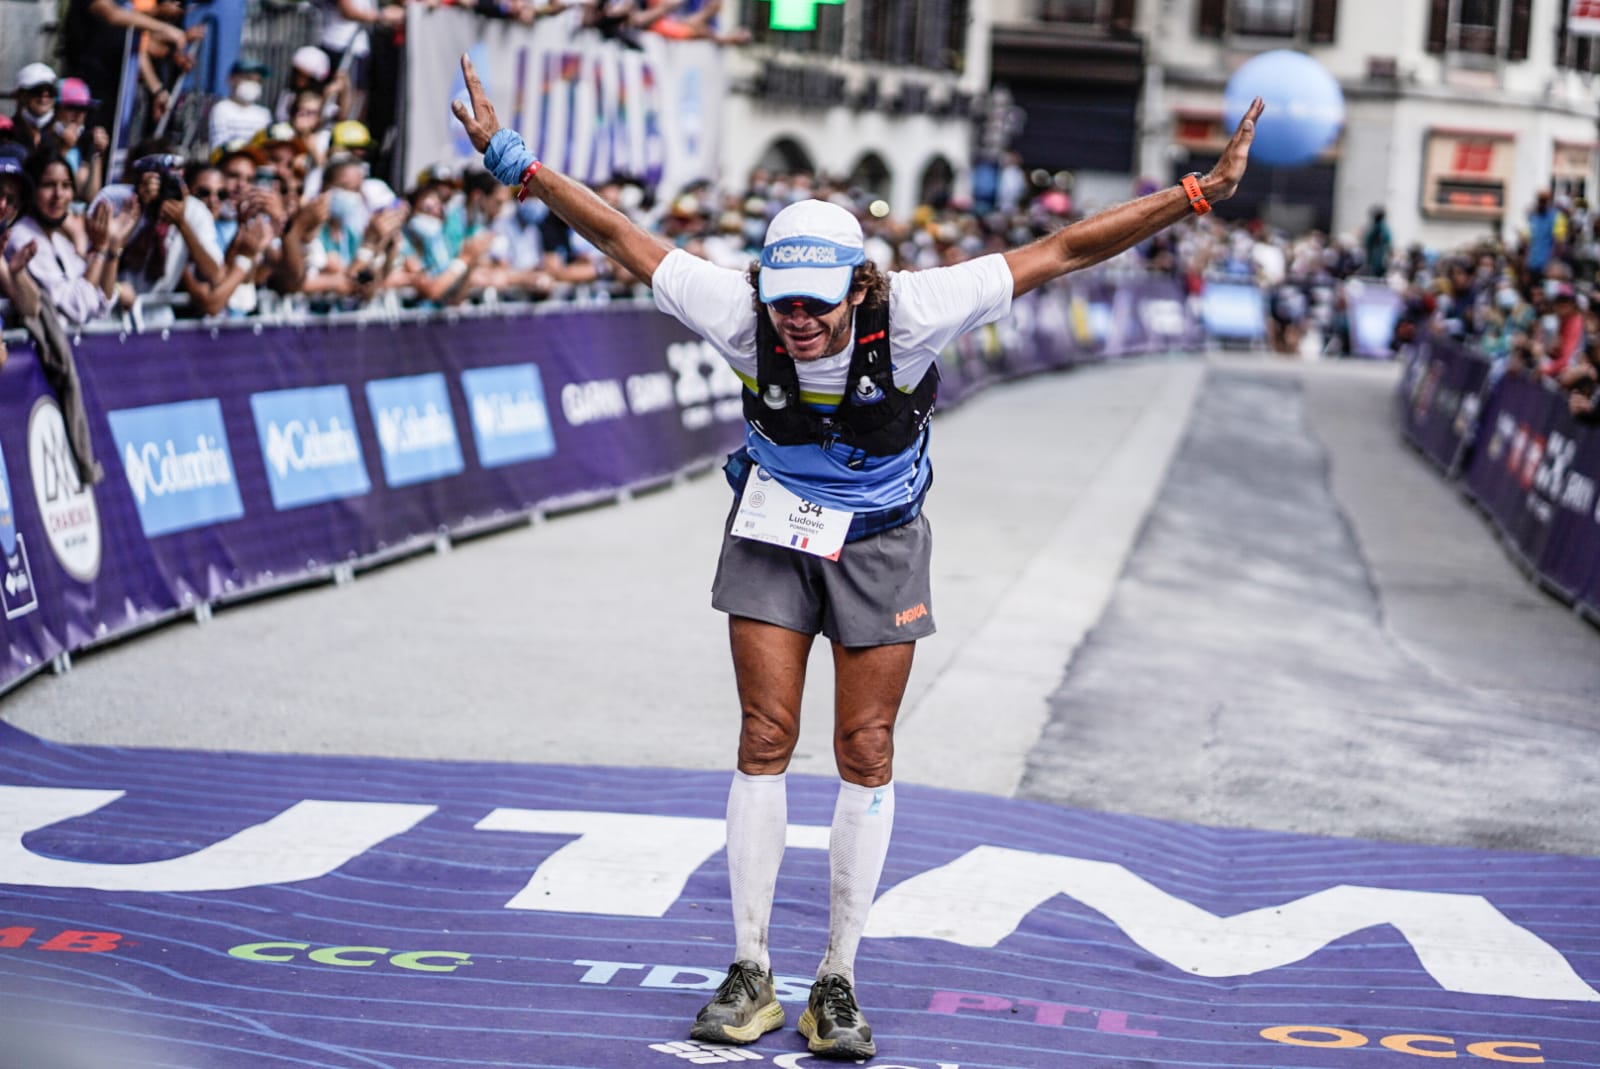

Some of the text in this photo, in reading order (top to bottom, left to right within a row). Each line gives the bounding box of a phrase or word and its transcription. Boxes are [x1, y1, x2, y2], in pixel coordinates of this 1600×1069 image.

[770, 246, 817, 263] HOKA
[798, 497, 824, 517] 34
[788, 513, 825, 530] Ludovic
[895, 602, 928, 627] HOKA
[927, 991, 1159, 1037] PTL
[1259, 1025, 1545, 1063] OCC
